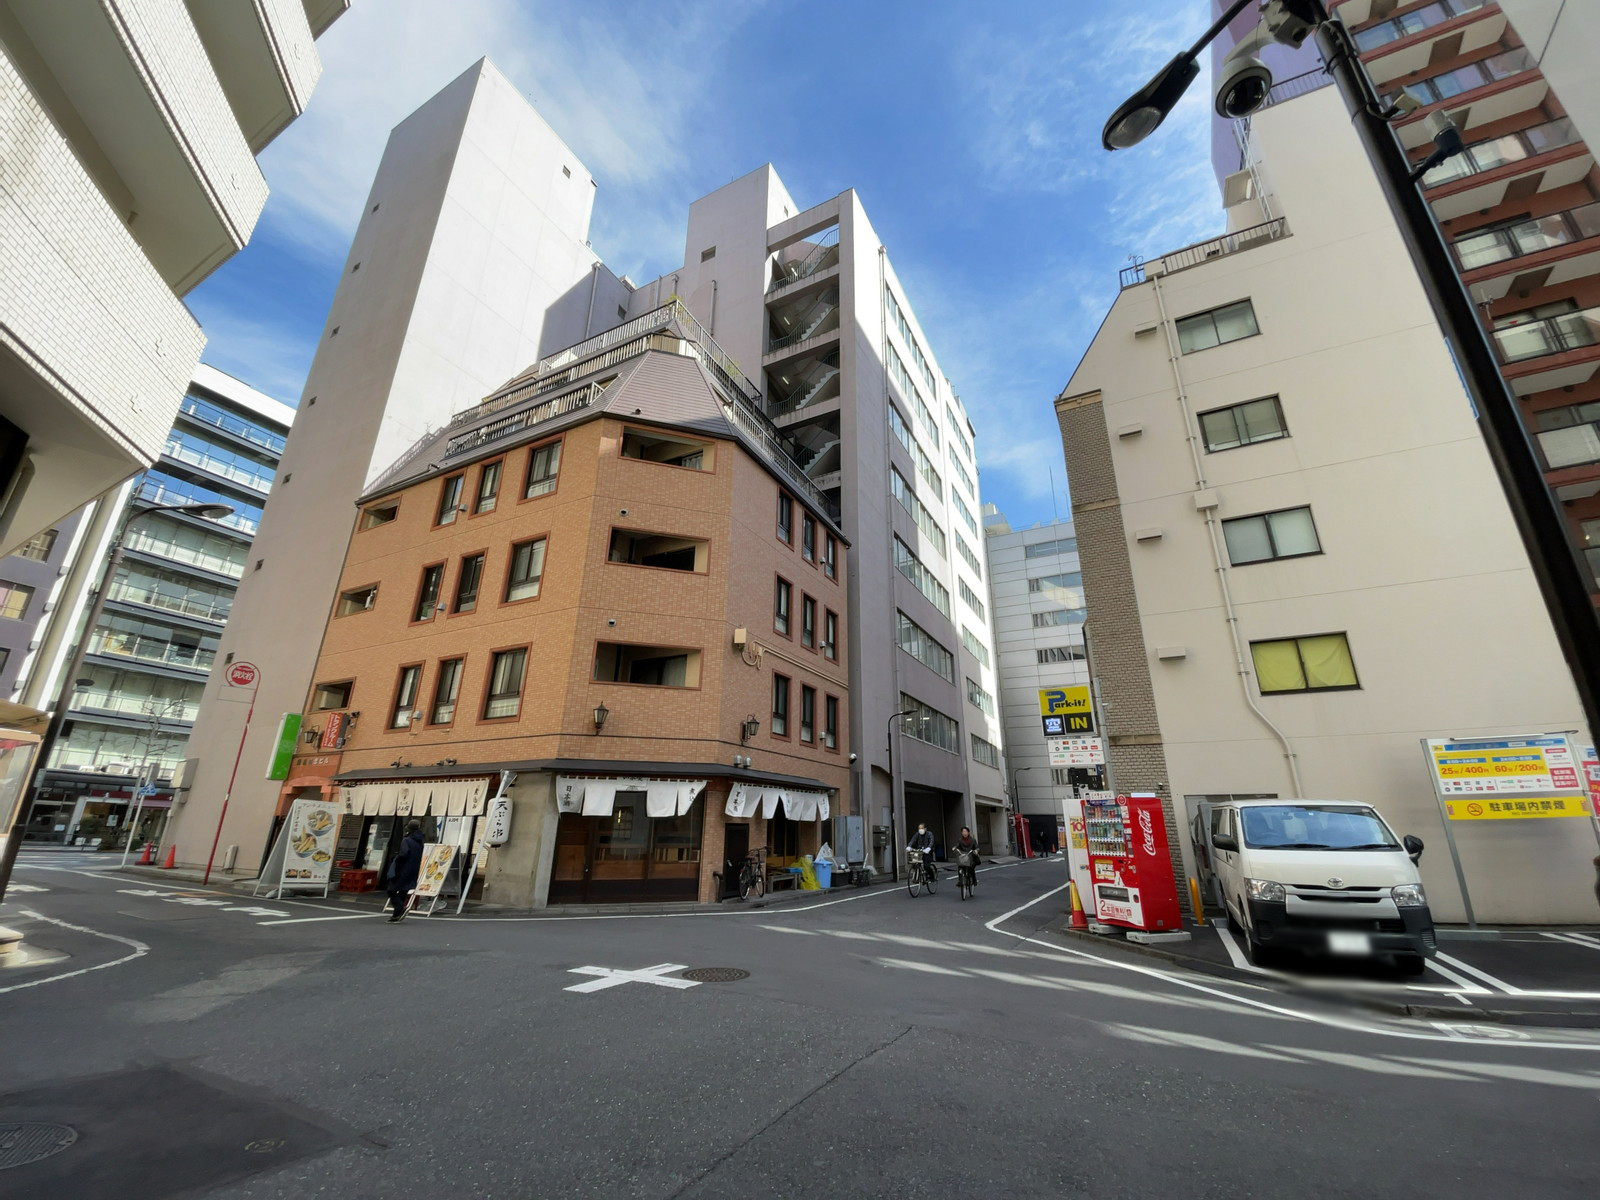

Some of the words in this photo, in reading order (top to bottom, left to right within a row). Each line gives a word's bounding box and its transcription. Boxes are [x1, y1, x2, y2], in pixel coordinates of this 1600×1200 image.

[1070, 717, 1088, 730] IN
[1489, 800, 1566, 812] 駐車場内禁煙
